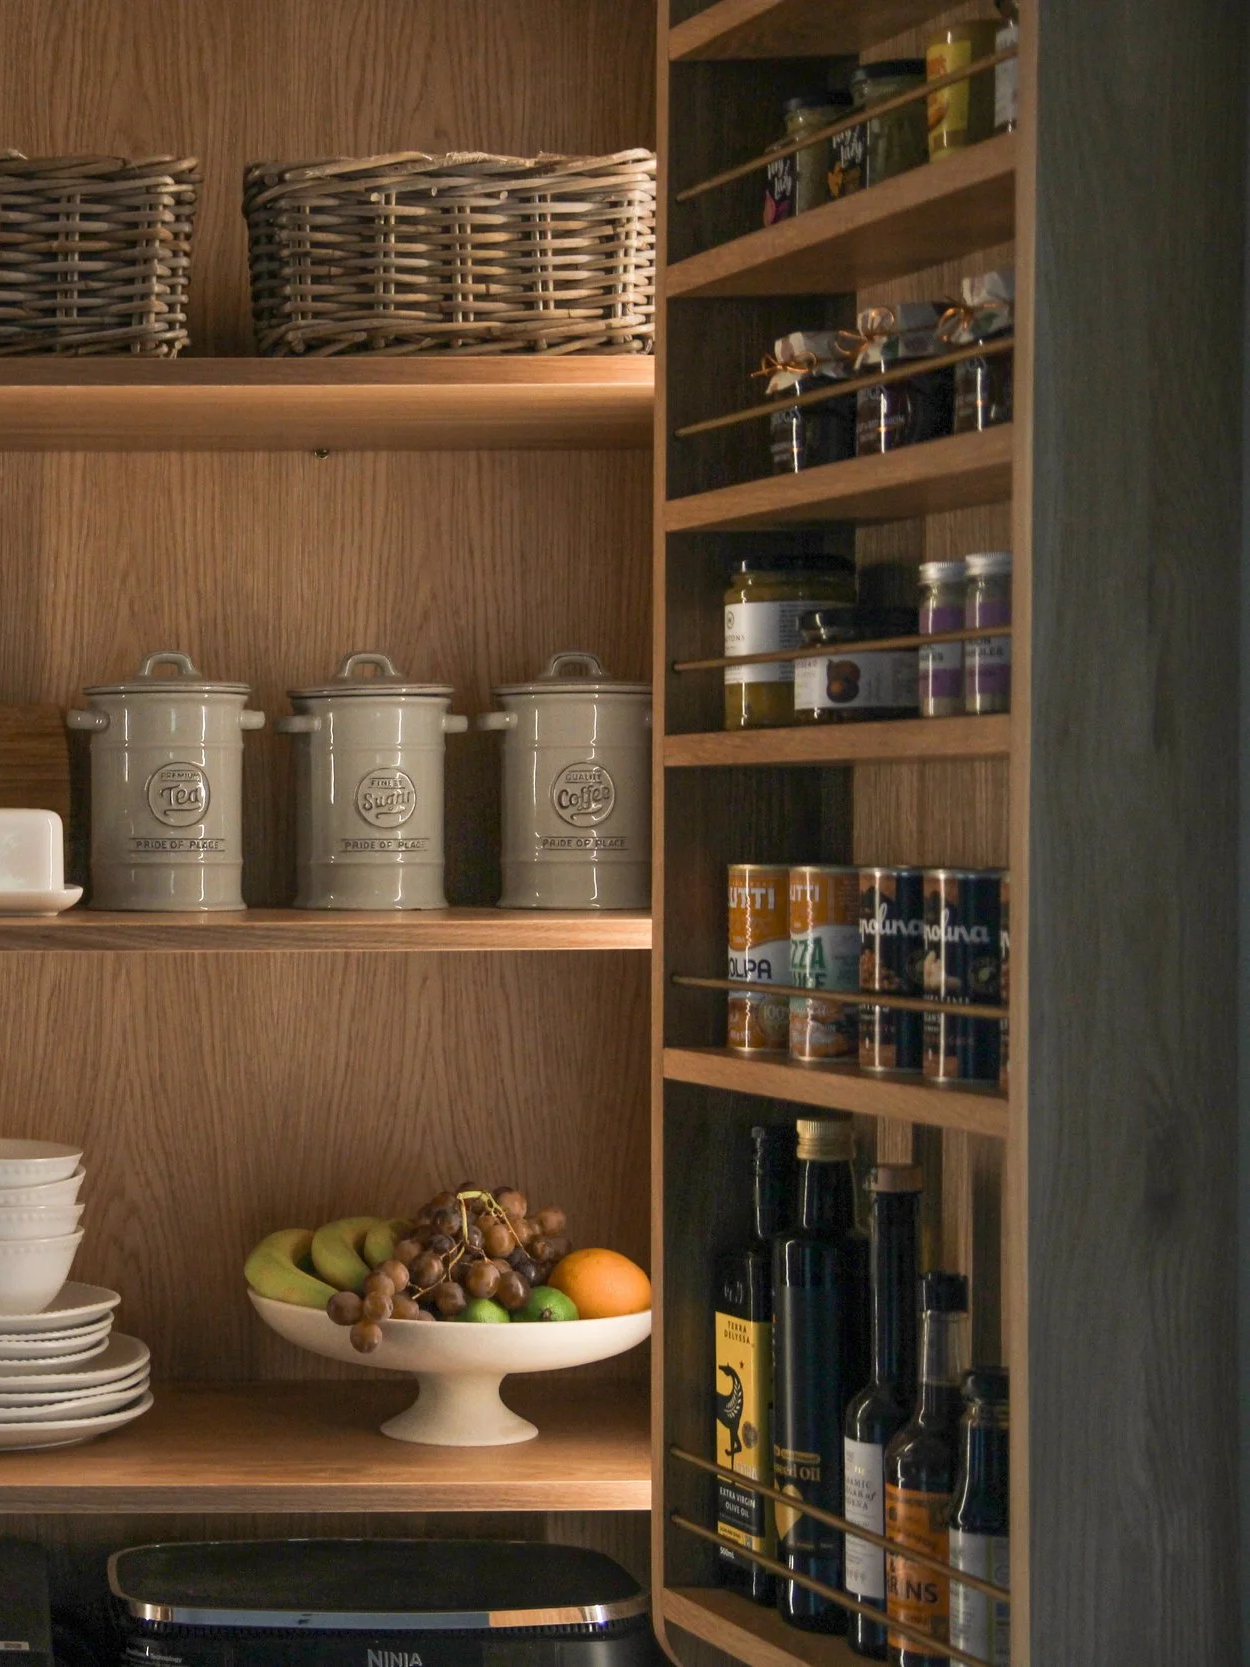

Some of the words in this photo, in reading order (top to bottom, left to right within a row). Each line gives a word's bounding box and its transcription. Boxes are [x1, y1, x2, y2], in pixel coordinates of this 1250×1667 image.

[160, 783, 201, 806] Tea
[557, 784, 610, 811] Coffee
[136, 840, 167, 849] PRIDE
[170, 840, 185, 849] OF
[189, 840, 220, 849] PLACE
[344, 841, 377, 849] PRIDE
[379, 841, 393, 849] OF
[542, 839, 572, 847] PRIDE
[576, 839, 591, 847] OF
[595, 839, 625, 847] PLACE
[727, 1320, 747, 1333] TERRA
[719, 1486, 736, 1500] EXTRA
[736, 1492, 756, 1509] VIRGIN
[725, 1501, 740, 1514] OLIVE
[740, 1507, 750, 1518] OIL
